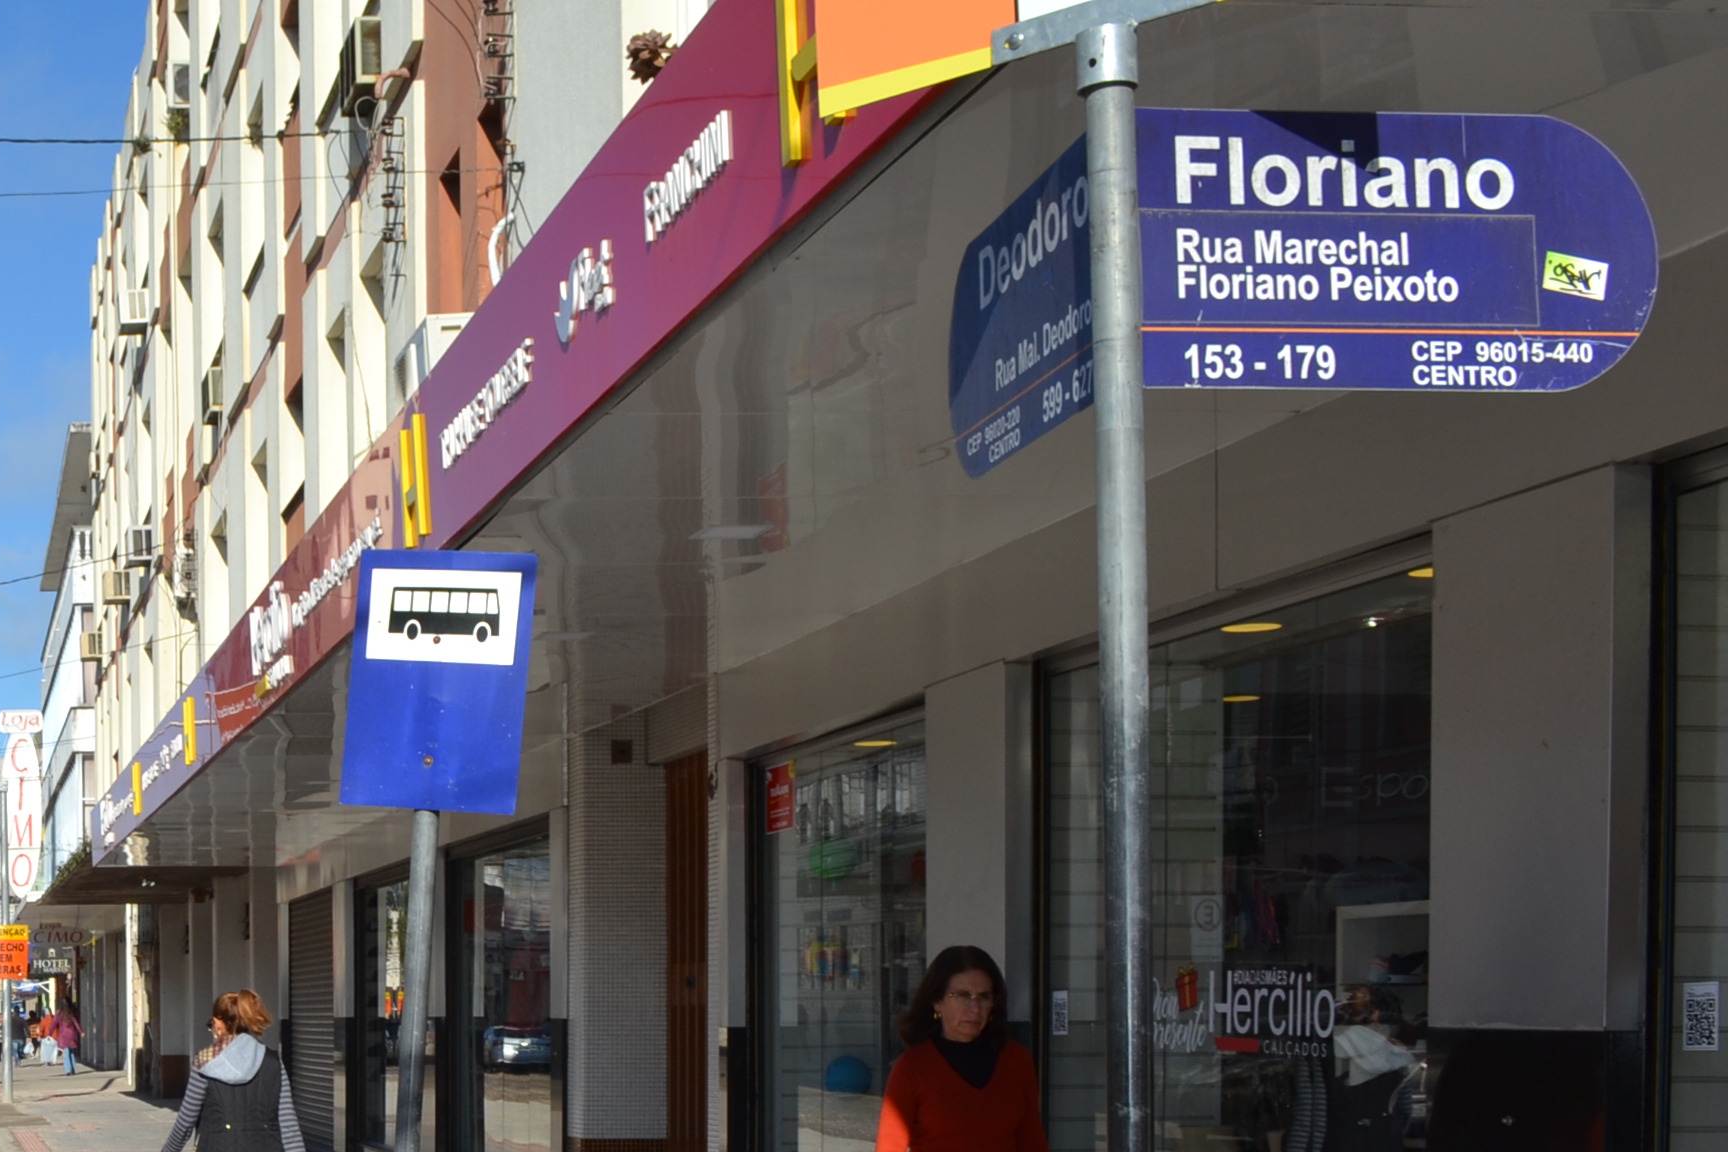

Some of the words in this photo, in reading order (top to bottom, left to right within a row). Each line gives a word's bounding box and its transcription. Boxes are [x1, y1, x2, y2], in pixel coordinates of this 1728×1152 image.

[1175, 135, 1514, 210] Floriano
[979, 176, 1090, 311] Deodoro
[1176, 228, 1243, 263] Rua
[1254, 230, 1409, 265] Marechal
[1177, 265, 1319, 301] Floriano
[1330, 267, 1459, 302] Peixoto
[995, 358, 1016, 391] Rua
[1018, 339, 1041, 375] Mal.
[1043, 299, 1092, 357] Deodoro
[1184, 344, 1244, 379] 153
[1277, 345, 1336, 380] 179
[1411, 341, 1462, 363] CEP
[1475, 342, 1594, 363] 96015-440
[1042, 381, 1062, 423] 599
[1073, 359, 1093, 404] 627
[1412, 365, 1517, 387] CENTRO
[967, 431, 982, 456] CEP
[989, 428, 1020, 463] CENTRO
[33, 930, 83, 943] CIMO
[0, 954, 13, 962] EM
[33, 959, 70, 968] HOTEL
[1209, 969, 1335, 1039] Hercílio
[1262, 1039, 1328, 1058] CALÇADOS
